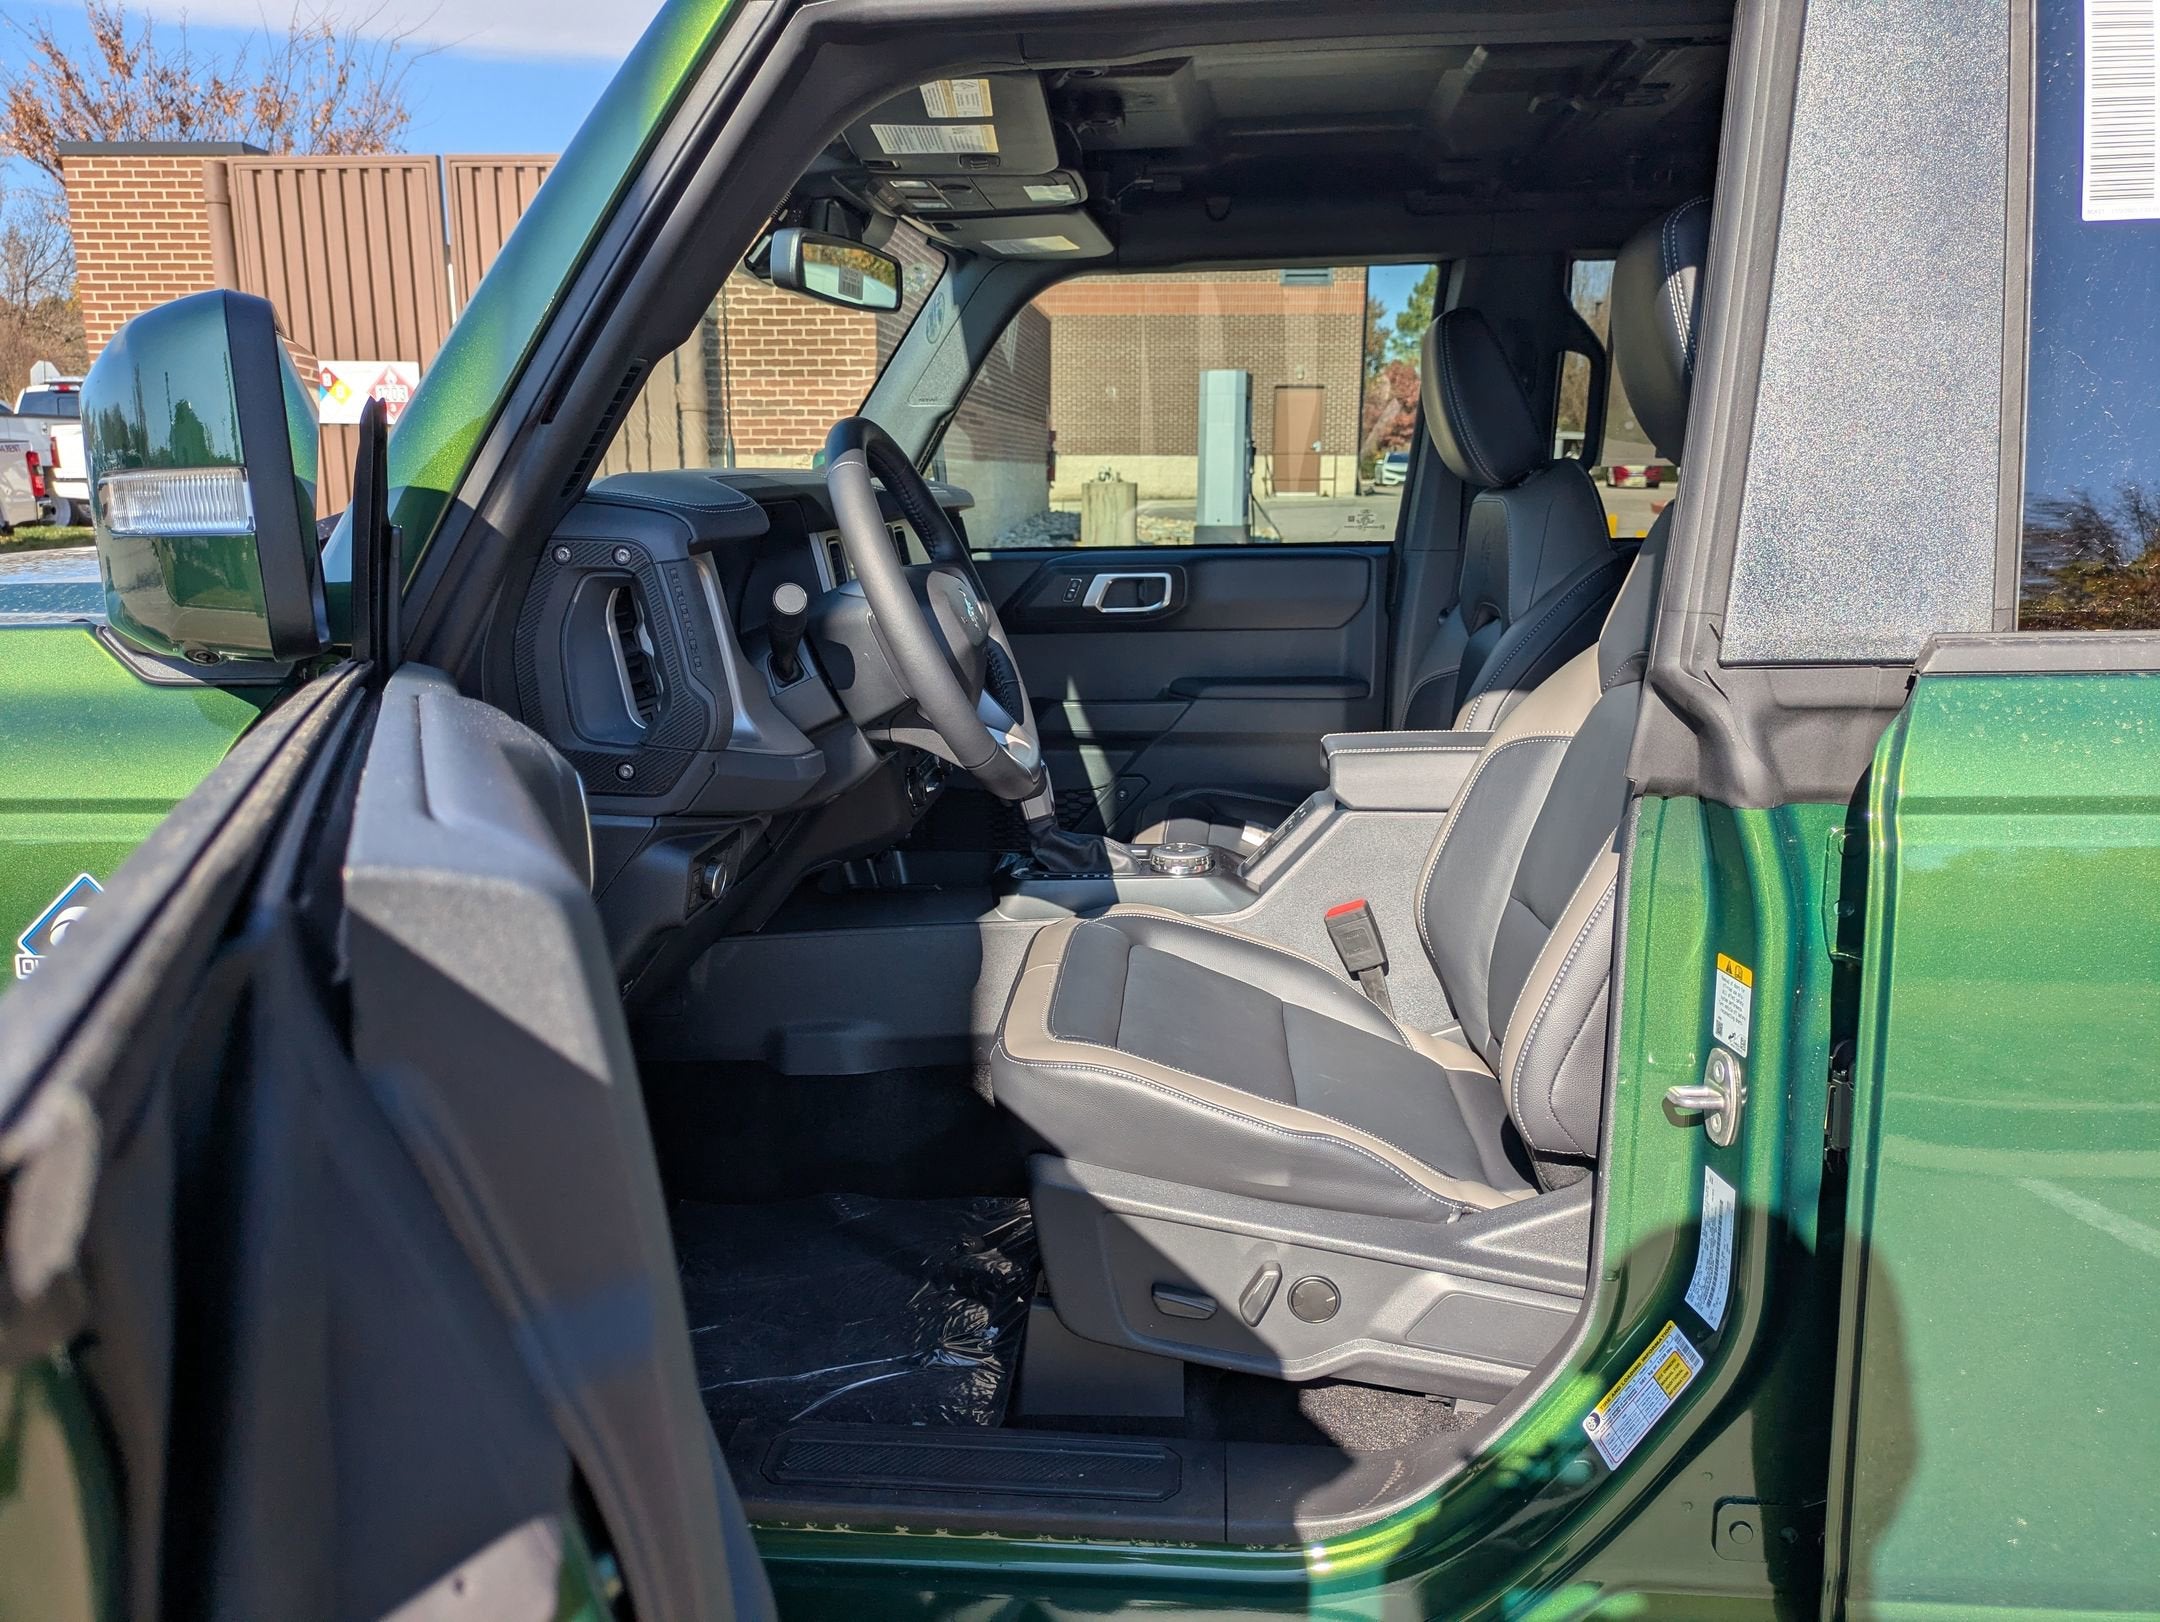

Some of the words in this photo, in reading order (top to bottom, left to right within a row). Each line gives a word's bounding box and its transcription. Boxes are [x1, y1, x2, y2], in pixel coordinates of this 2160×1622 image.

[377, 386, 406, 401] 1203
[1599, 1395, 1612, 1411] TIRE
[1610, 1384, 1621, 1398] AND
[1619, 1360, 1642, 1386] LOADING
[1641, 1323, 1673, 1362] INFORMATION
